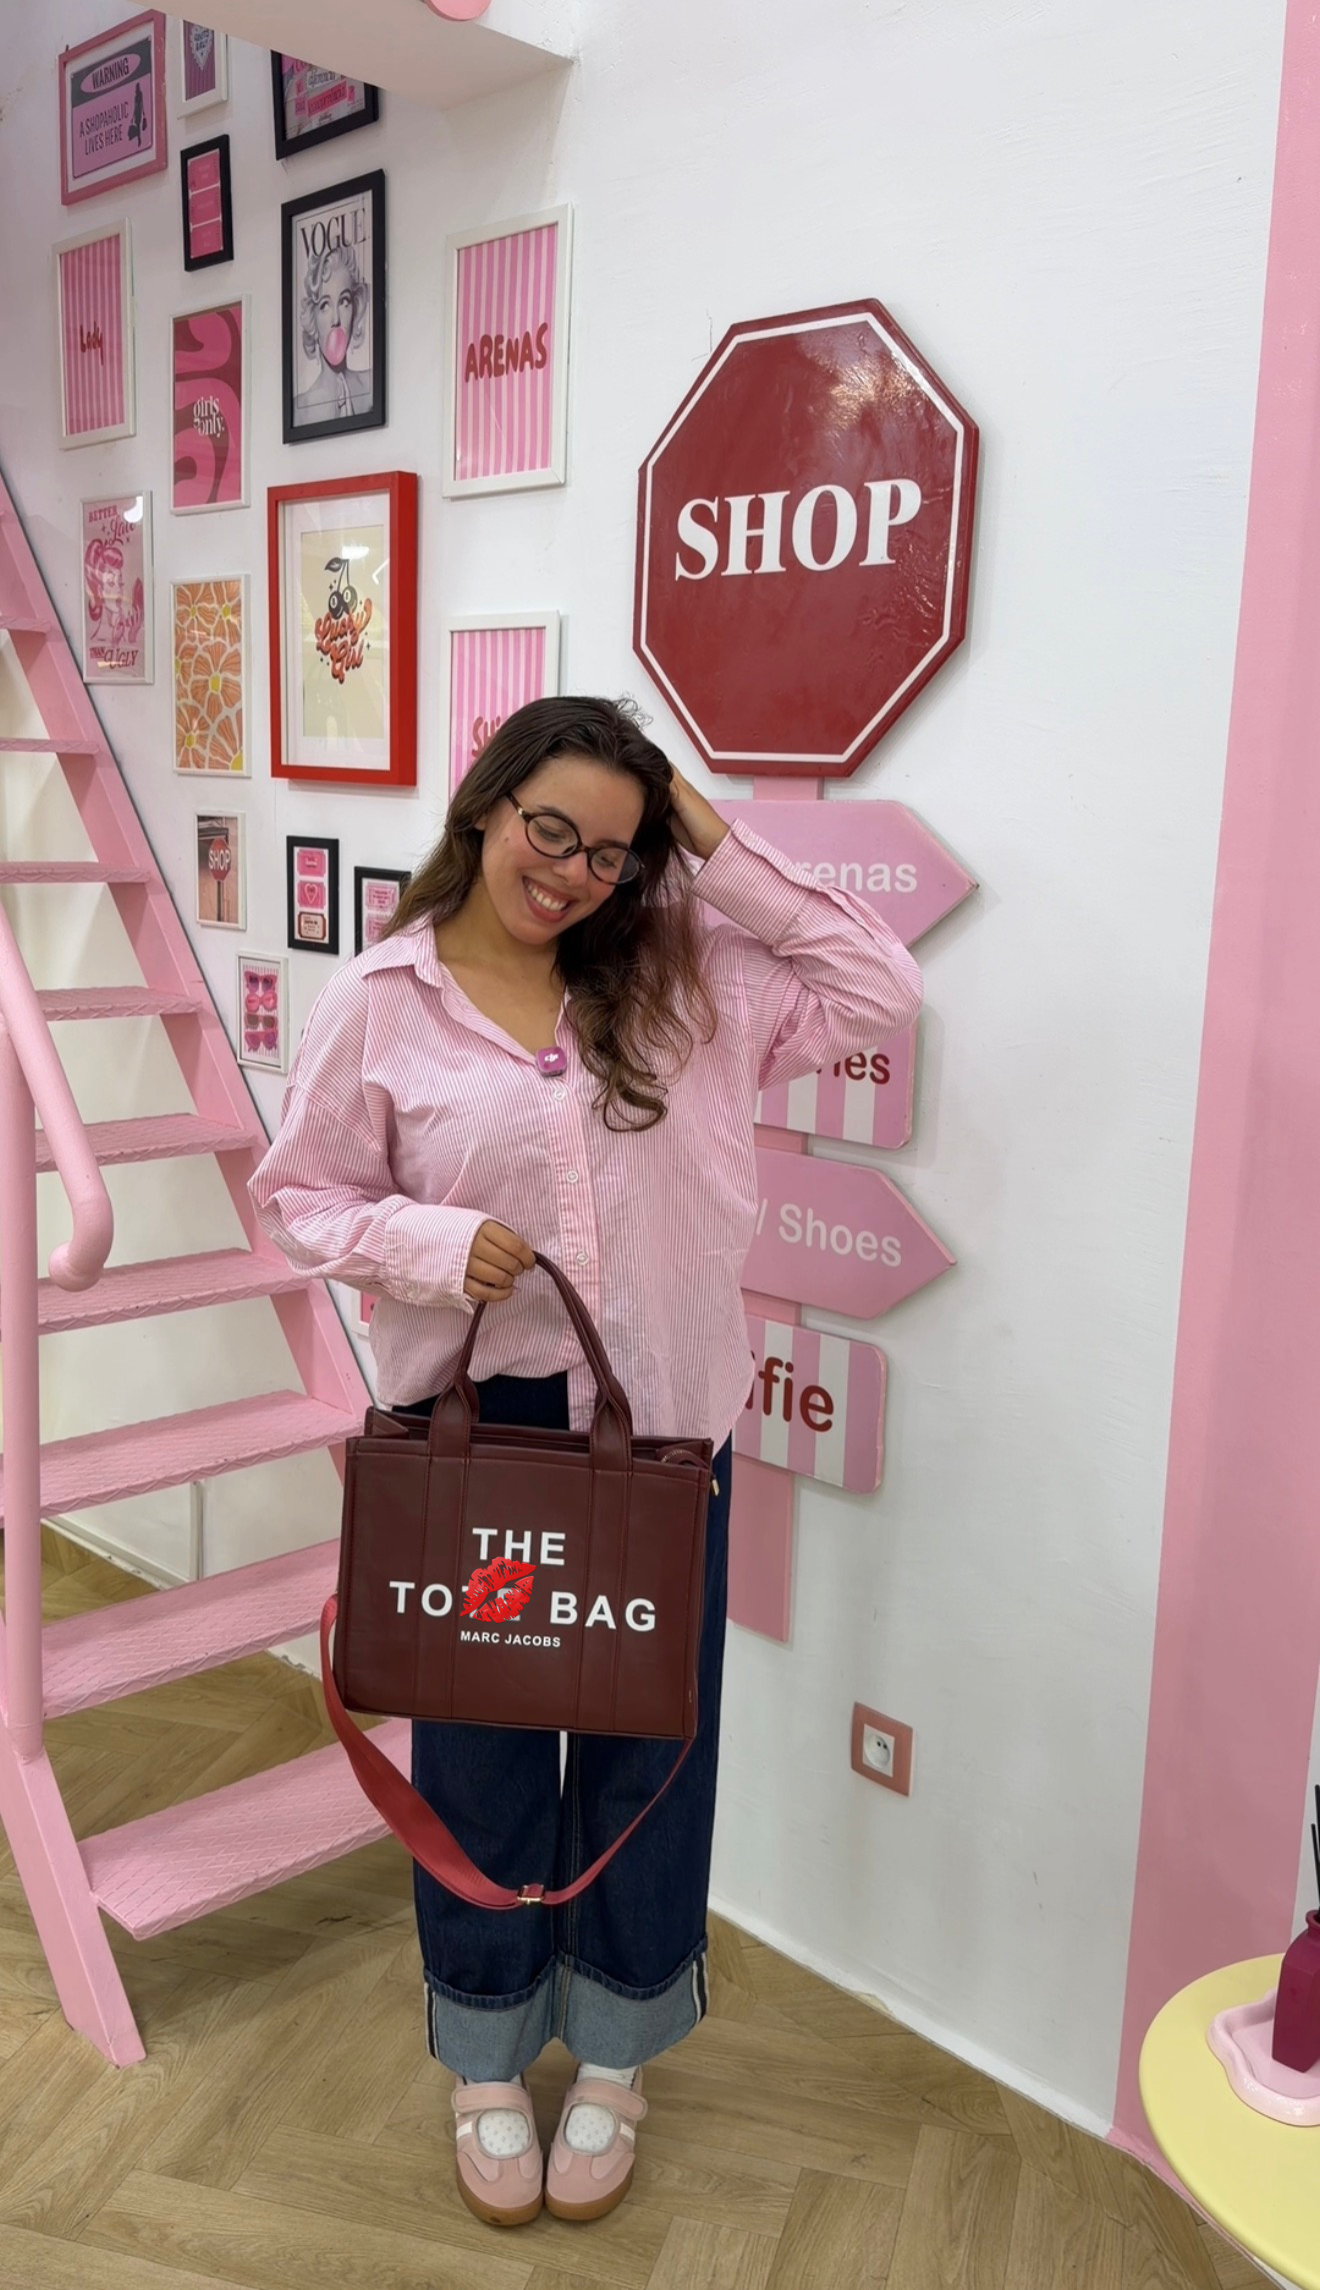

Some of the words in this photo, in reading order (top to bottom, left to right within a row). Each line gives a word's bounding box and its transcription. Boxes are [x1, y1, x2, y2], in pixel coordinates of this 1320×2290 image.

[91, 57, 130, 90] WARNING
[85, 101, 129, 136] SHOPAHOLIC
[85, 131, 105, 156] LIVES
[104, 124, 123, 147] HERE
[300, 207, 366, 260] VOGUE
[464, 322, 548, 383] ARENAS
[88, 504, 118, 523] BETTER
[674, 477, 923, 582] SHOP
[209, 849, 231, 870] SHOP
[778, 1203, 902, 1267] Shoes
[472, 1527, 566, 1566] THE
[389, 1580, 521, 1622] TO
[550, 1590, 656, 1632] BAG
[460, 1630, 500, 1645] MARC
[504, 1633, 561, 1648] JACOBS
